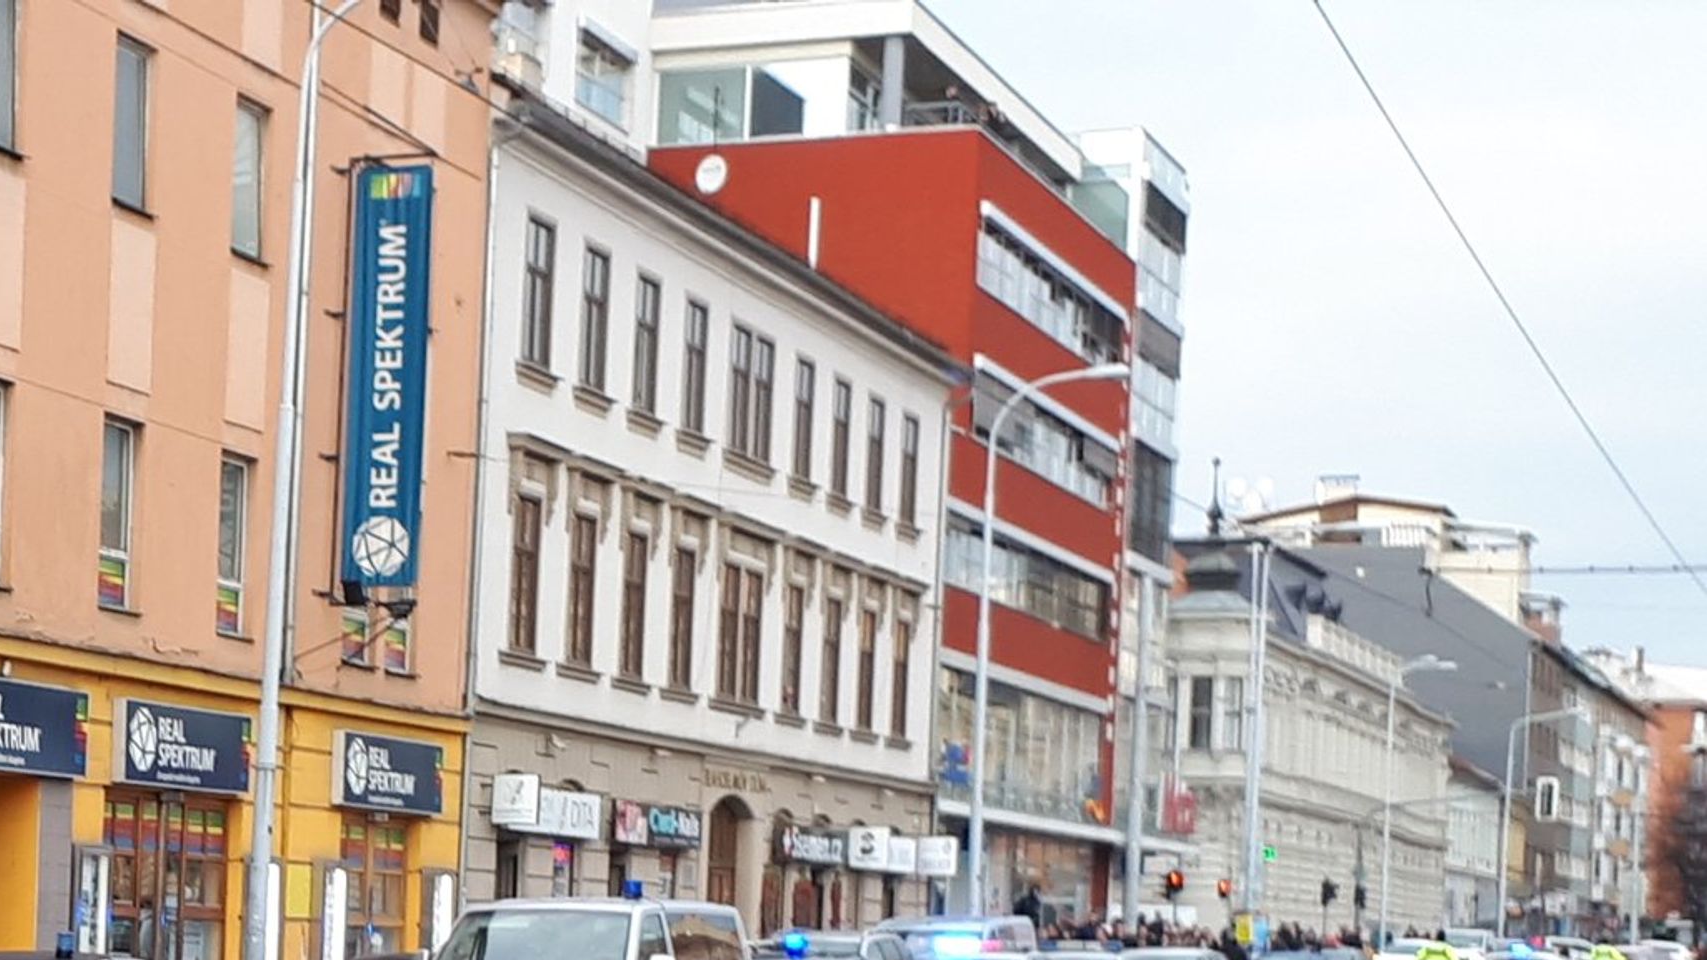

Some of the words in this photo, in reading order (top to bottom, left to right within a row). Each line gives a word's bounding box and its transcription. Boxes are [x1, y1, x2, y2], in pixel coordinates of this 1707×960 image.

[372, 223, 407, 411] SPEKTRUM
[370, 421, 400, 508] REAL
[158, 716, 186, 743] REAL
[157, 742, 216, 772] SPEKTRUM
[369, 745, 391, 770] REAL
[368, 769, 415, 796] SPEKTRUM
